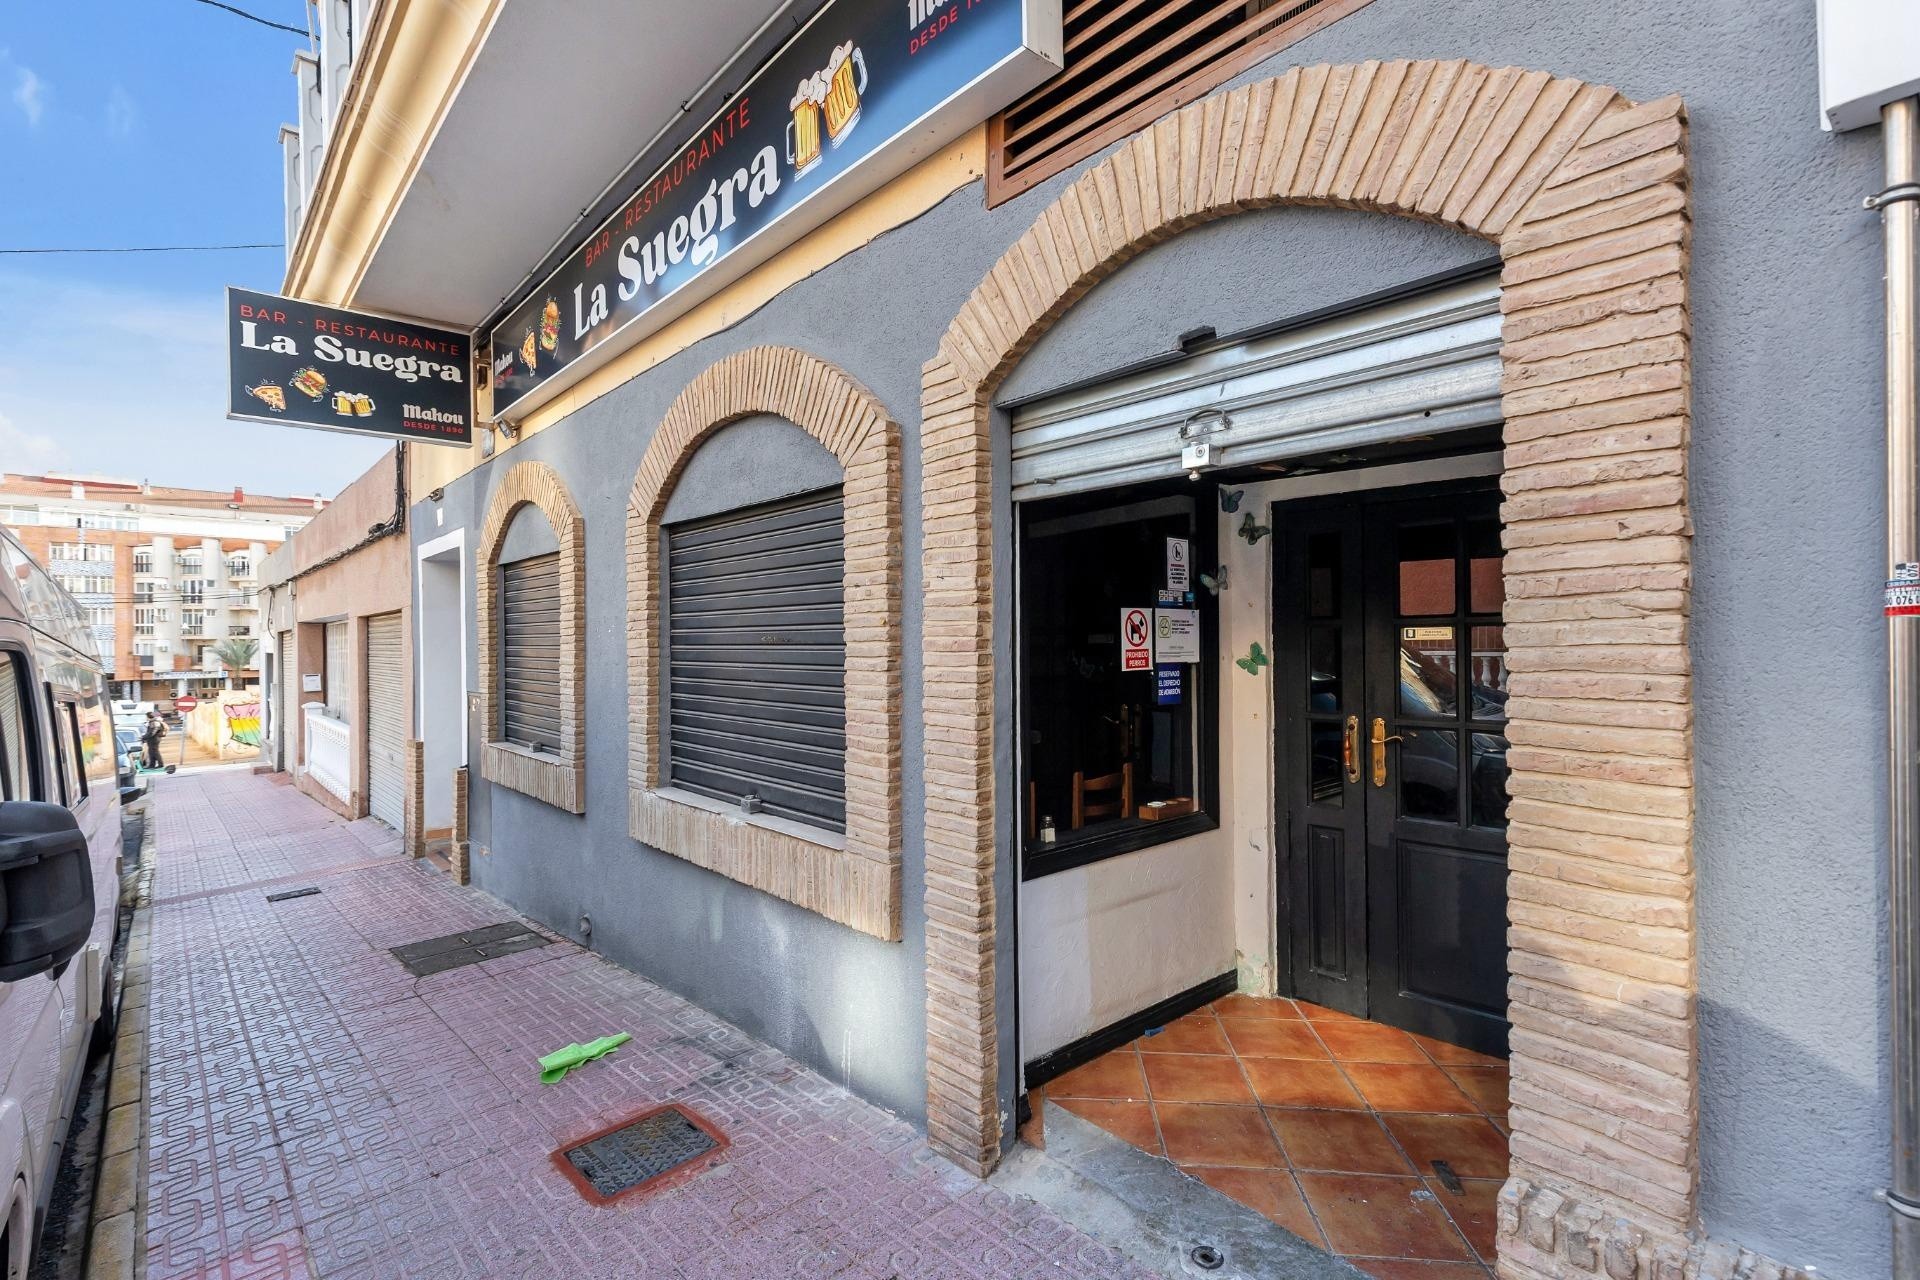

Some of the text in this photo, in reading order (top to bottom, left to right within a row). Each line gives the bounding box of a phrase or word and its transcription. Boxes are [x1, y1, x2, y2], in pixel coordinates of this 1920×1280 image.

[910, 5, 958, 55] DESDE
[585, 231, 609, 269] BAR
[625, 98, 750, 230] RESTAURANTE
[574, 145, 781, 341] La Suegra
[240, 304, 287, 325] BAR
[315, 319, 460, 356] RESTAURANTE
[240, 320, 299, 356] La
[314, 334, 464, 383] Suegra
[402, 403, 464, 425] Mahou
[403, 420, 436, 432] DESDE
